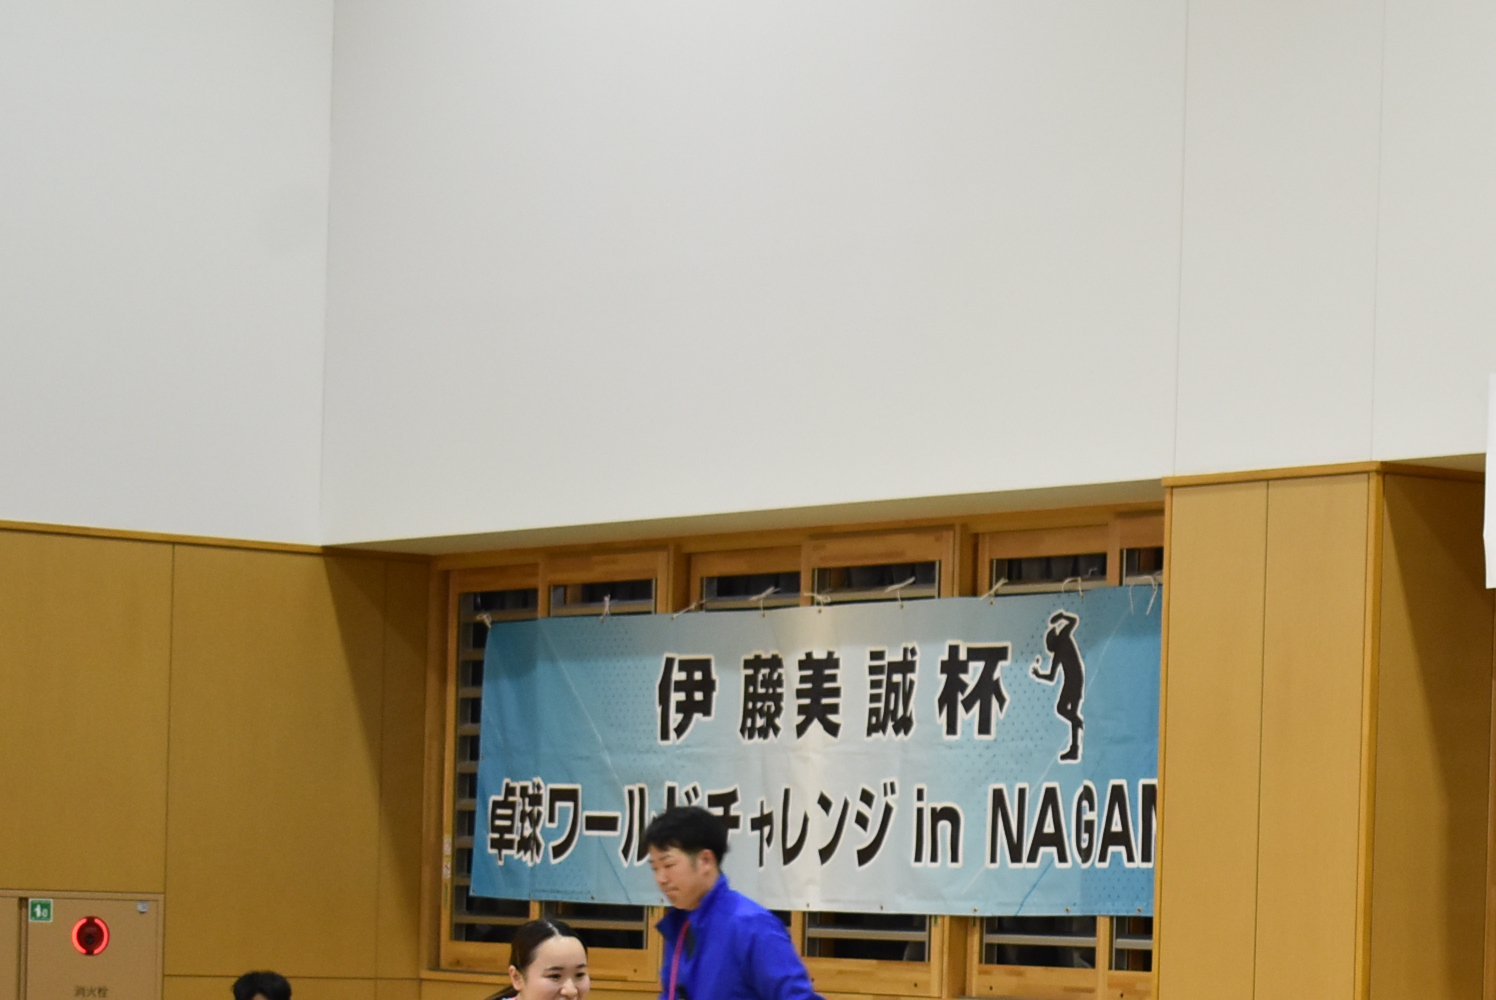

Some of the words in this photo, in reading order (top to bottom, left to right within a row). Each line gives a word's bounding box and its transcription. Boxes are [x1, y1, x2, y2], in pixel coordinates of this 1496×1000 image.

[656, 642, 1011, 744] 伊藤美誠杯
[912, 786, 963, 867] in
